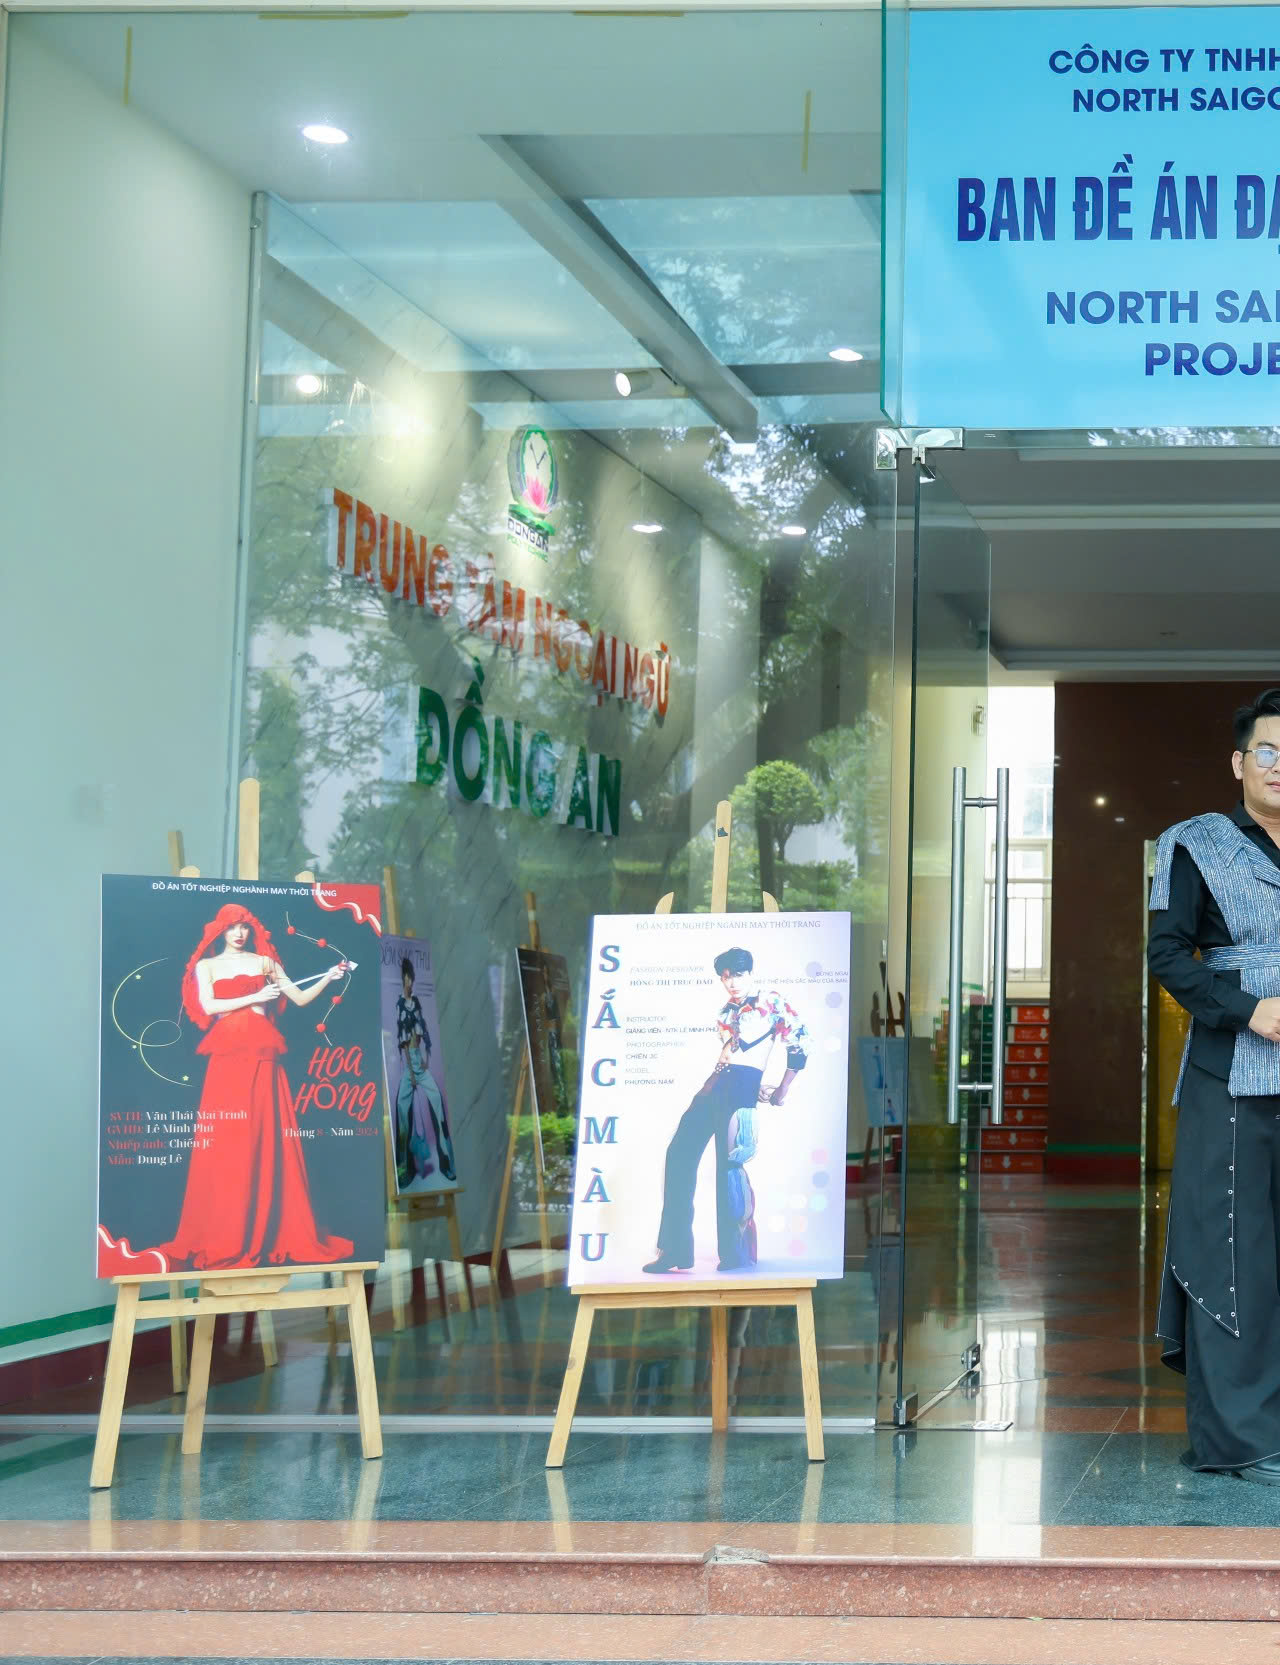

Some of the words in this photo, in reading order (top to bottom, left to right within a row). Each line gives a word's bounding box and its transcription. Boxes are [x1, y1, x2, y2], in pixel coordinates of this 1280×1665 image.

[1049, 43, 1150, 74] CÔNG
[1160, 48, 1195, 73] TY
[1073, 87, 1179, 113] NORTH
[957, 176, 1056, 242] BAN
[1073, 153, 1134, 241] ĐỀ
[1150, 160, 1218, 241] ÁN
[1046, 290, 1199, 325] NORTH
[332, 487, 454, 618] TRUNG
[416, 656, 558, 819] ĐỒNG
[567, 743, 622, 837] AN
[152, 881, 166, 891] ĐỒ
[167, 882, 180, 892] ÁN
[181, 881, 199, 892] TỐT
[200, 884, 231, 894] NGHIỆP
[233, 884, 269, 895] NGHÀNH
[270, 887, 288, 895] MAY
[290, 887, 309, 896] THỜI
[311, 888, 337, 897] TRANG
[749, 920, 768, 929] MAY
[793, 920, 821, 929] TRANG
[146, 1123, 160, 1134] Lê
[163, 1123, 191, 1134] Minh
[330, 1127, 354, 1137] Năm
[168, 1153, 183, 1164] Lê
